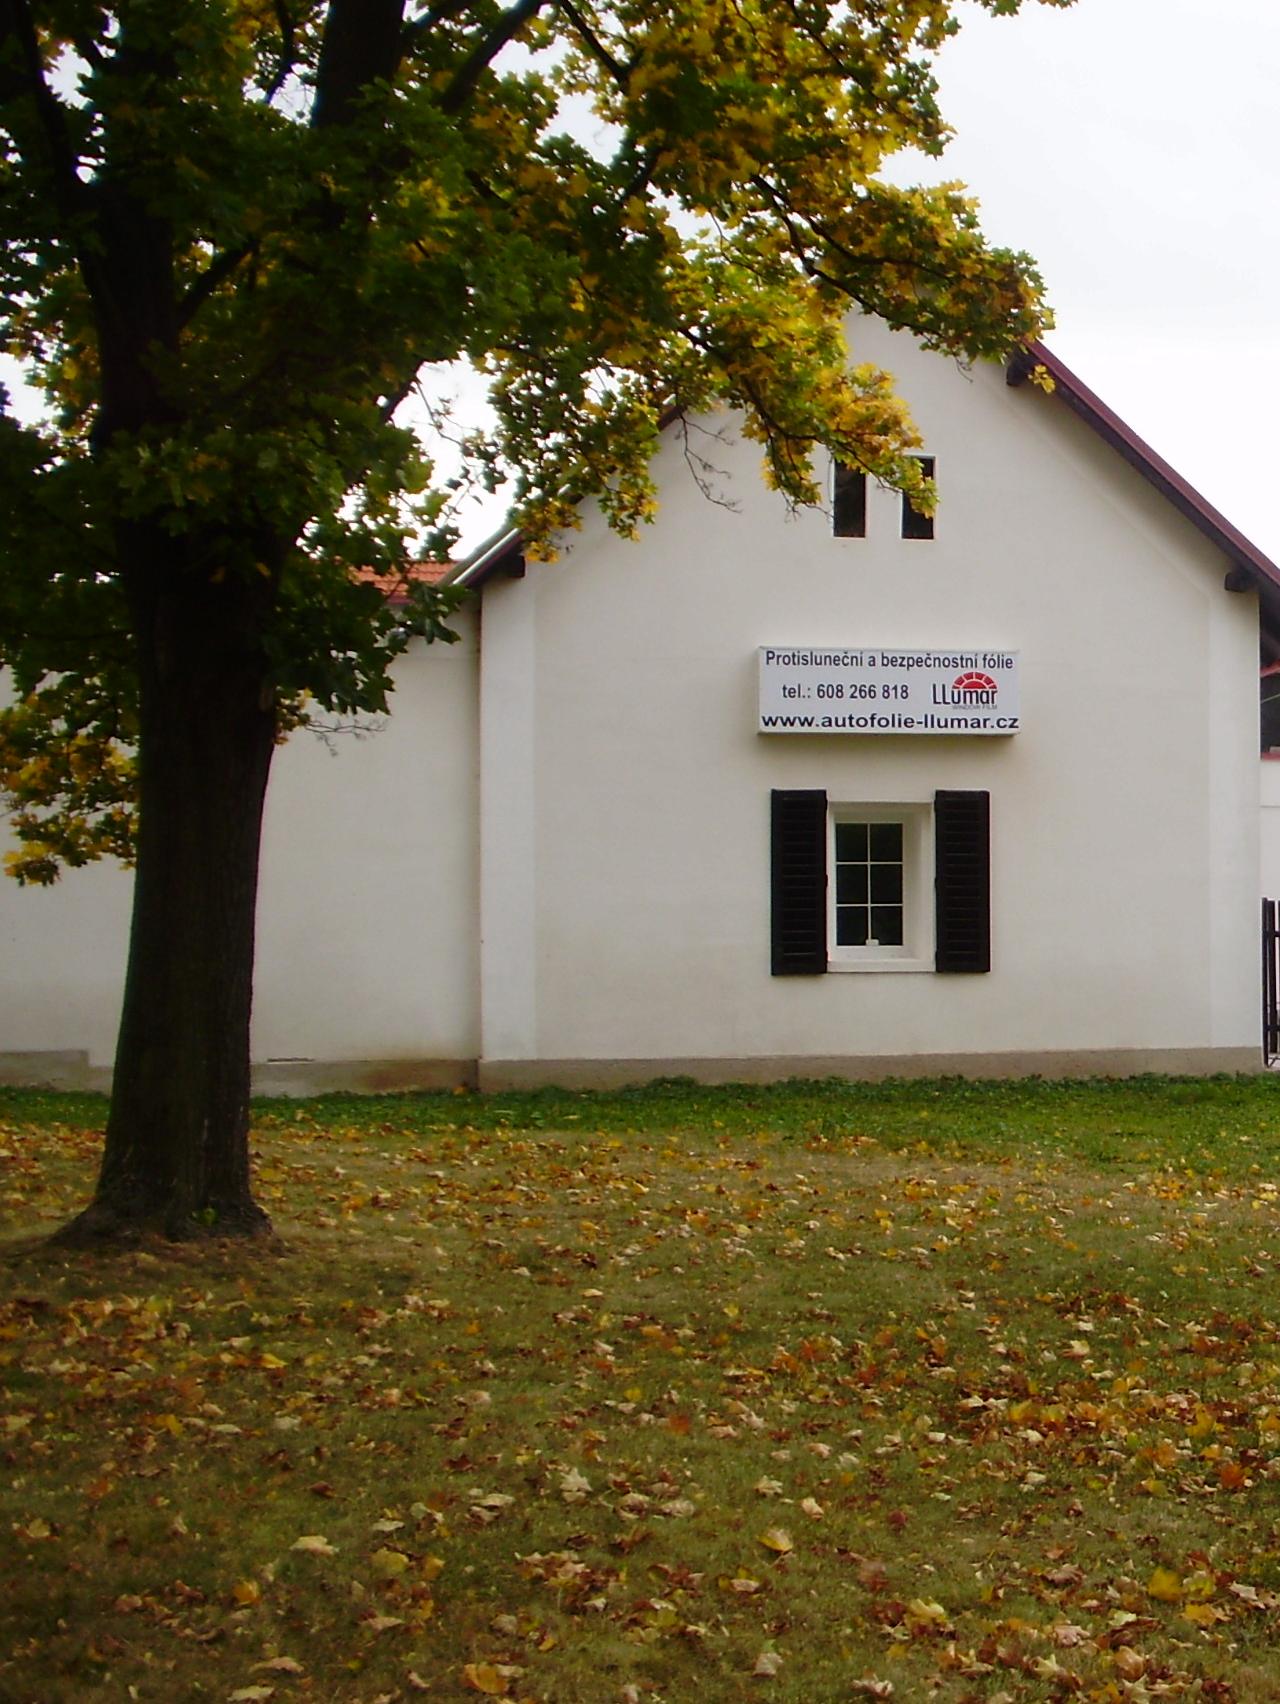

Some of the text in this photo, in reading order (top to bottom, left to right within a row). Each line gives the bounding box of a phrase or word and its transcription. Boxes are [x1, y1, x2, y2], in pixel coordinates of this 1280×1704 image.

[766, 650, 1013, 671] Protisluneční a bezpečnostní fólie
[782, 684, 909, 699] tel.: 608 266 818
[762, 713, 1019, 729] www.autofolie-llumar.cz
